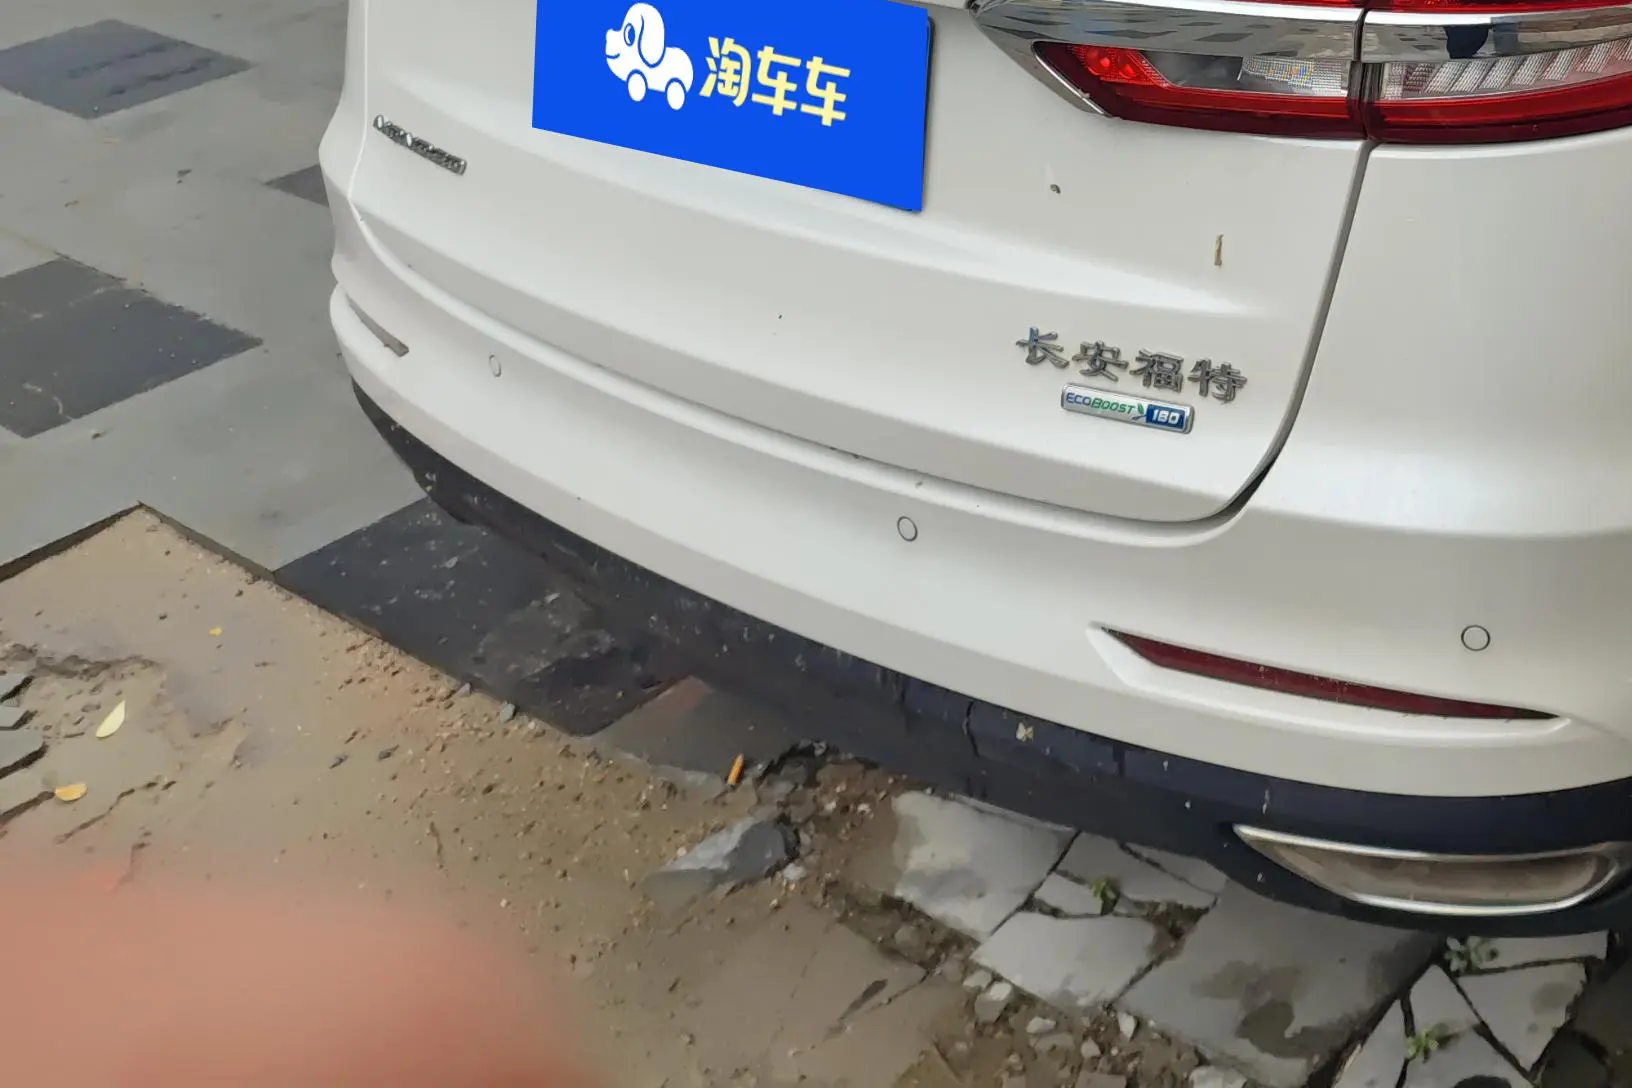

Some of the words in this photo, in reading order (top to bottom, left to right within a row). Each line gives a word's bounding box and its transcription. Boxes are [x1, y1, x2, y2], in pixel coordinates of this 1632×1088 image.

[1015, 326, 1248, 403] 长安福特
[1150, 407, 1181, 425] 180
